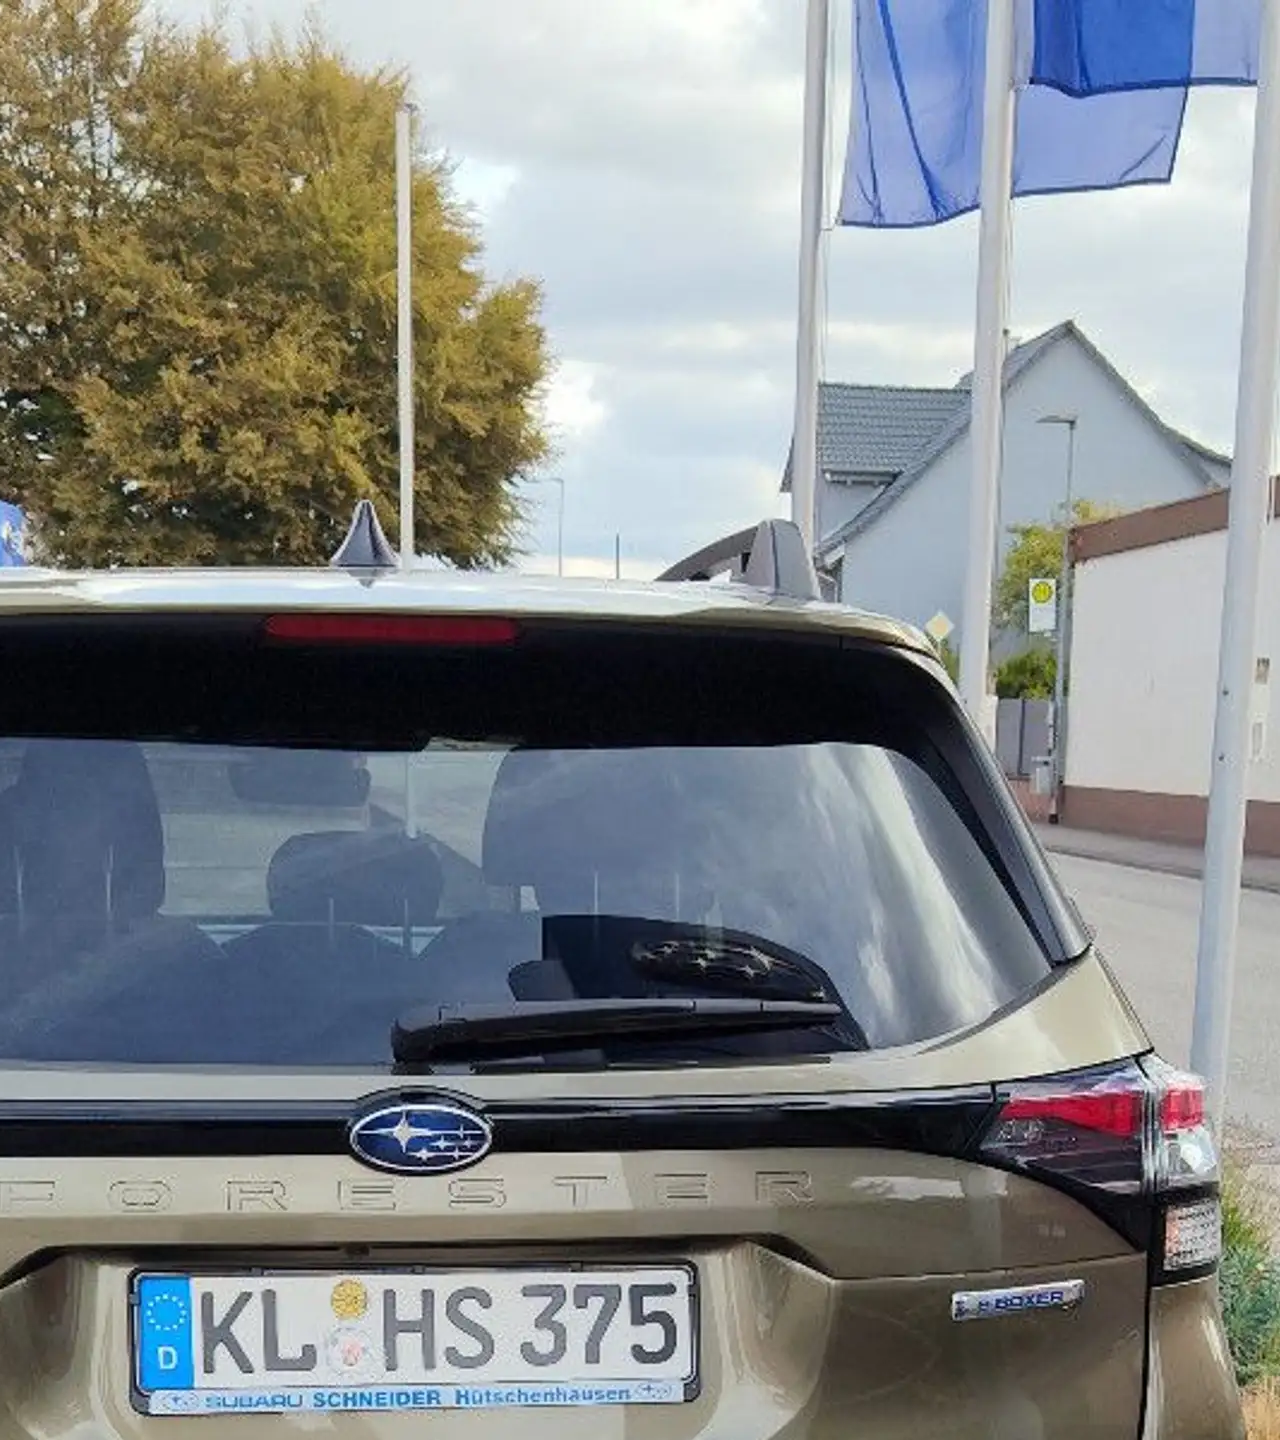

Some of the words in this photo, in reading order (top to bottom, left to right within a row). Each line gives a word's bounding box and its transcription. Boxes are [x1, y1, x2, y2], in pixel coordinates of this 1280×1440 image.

[200, 1289, 317, 1374] KL
[382, 1287, 496, 1371] HS
[518, 1284, 677, 1367] 375
[157, 1346, 177, 1370] D
[204, 1393, 303, 1409] SUBARU
[312, 1389, 441, 1408] SCHNEIDER
[454, 1385, 631, 1406] Hütschenhausen
